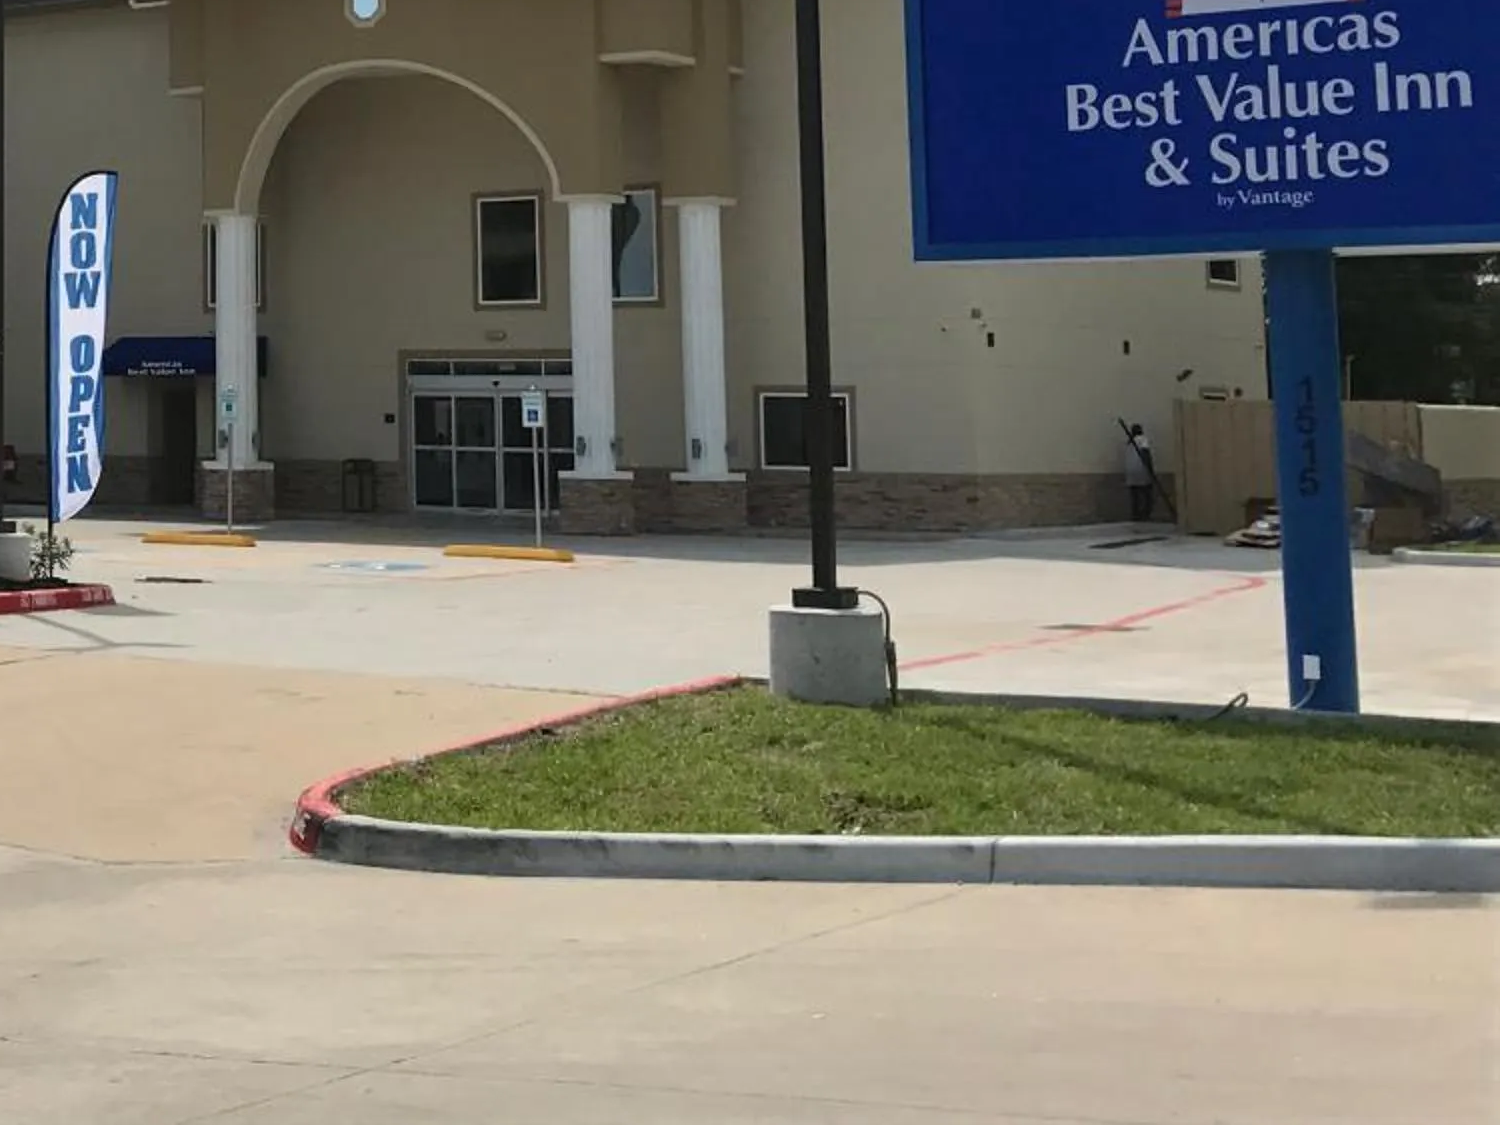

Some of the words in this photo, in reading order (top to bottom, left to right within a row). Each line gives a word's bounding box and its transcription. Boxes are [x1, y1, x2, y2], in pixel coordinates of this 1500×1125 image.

[1122, 10, 1400, 68] Americas
[1066, 79, 1182, 132] Best
[1195, 64, 1355, 123] Value
[1374, 61, 1473, 113] Inn
[1145, 138, 1191, 188] &
[1210, 126, 1390, 184] Suites
[1217, 193, 1235, 210] by
[1237, 189, 1315, 208] Vantage
[63, 192, 102, 309] NOW
[67, 334, 96, 493] OPEN
